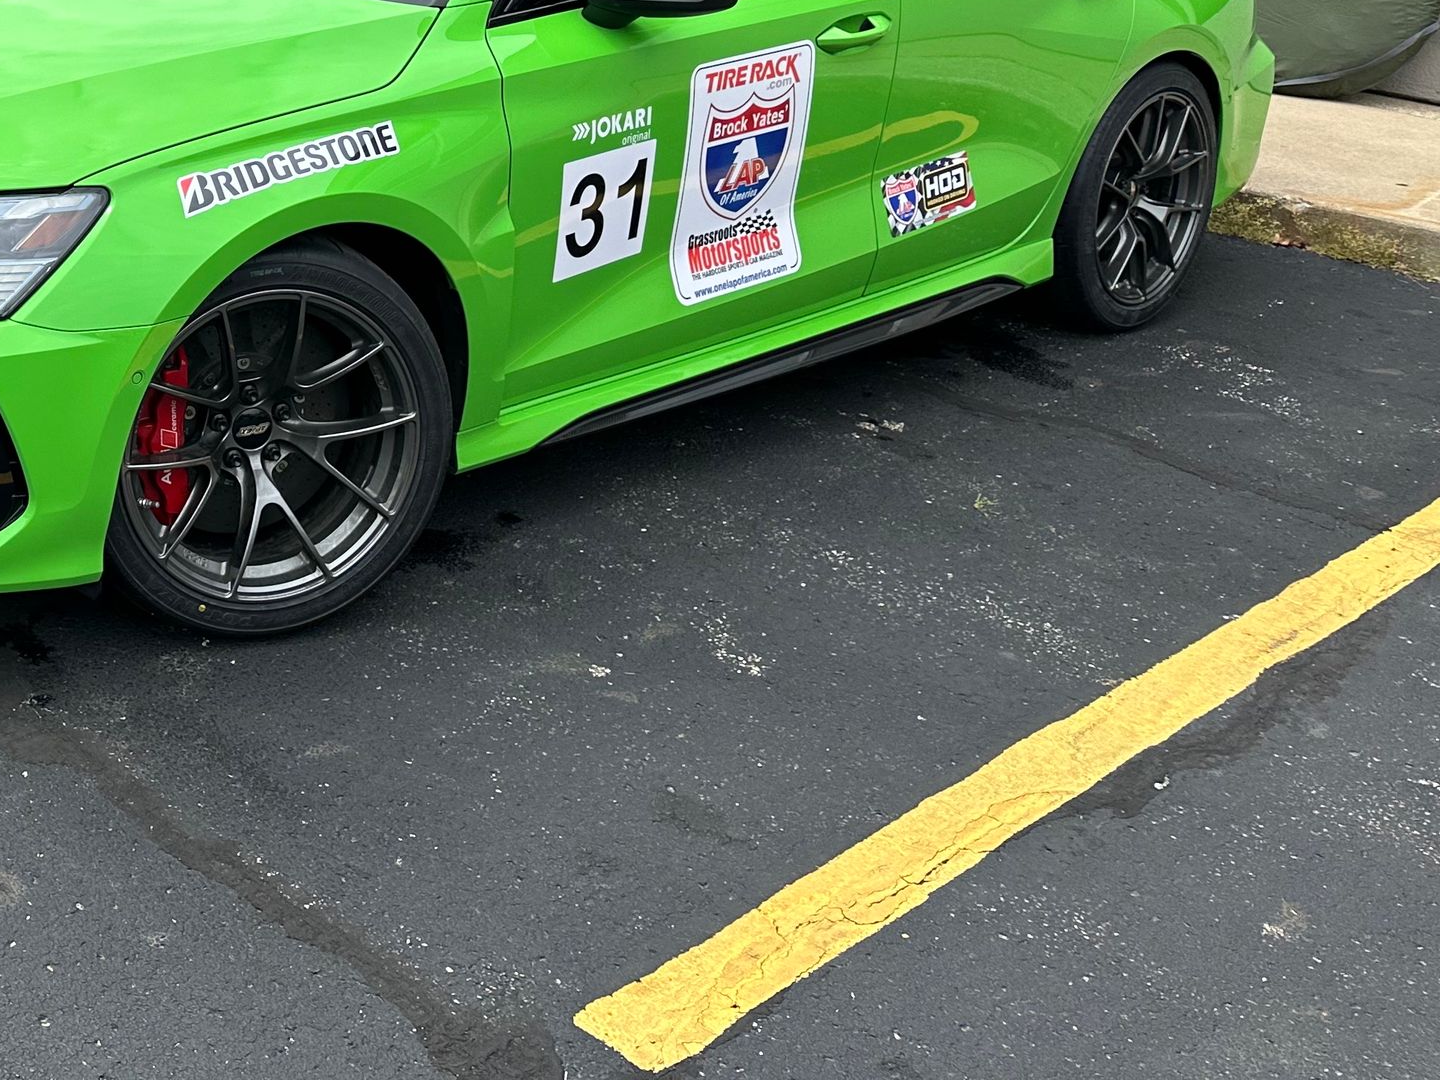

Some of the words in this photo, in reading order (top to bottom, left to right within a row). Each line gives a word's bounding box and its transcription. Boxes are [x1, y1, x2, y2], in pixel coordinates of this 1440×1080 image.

[705, 65, 748, 94] TIRE
[749, 53, 800, 83] RACK
[766, 77, 792, 90] .com
[590, 106, 652, 145] JOKARI
[621, 128, 651, 146] original
[713, 116, 748, 139] Brock
[752, 104, 789, 129] Yates'
[182, 124, 397, 214] BRIDGESTONE
[718, 157, 766, 194] LAP
[924, 166, 965, 199] HOD
[565, 157, 648, 258] 31
[720, 193, 731, 206] Of
[729, 188, 758, 204] America
[688, 223, 740, 250] Grassroots
[688, 226, 781, 274] Motorsports
[692, 272, 702, 281] THE
[701, 266, 727, 278] HARDCORE
[727, 260, 745, 273] SPORTS
[749, 256, 759, 265] CAR
[759, 248, 783, 262] MAGAZINE
[694, 264, 788, 298] www.onelapofamerica.com
